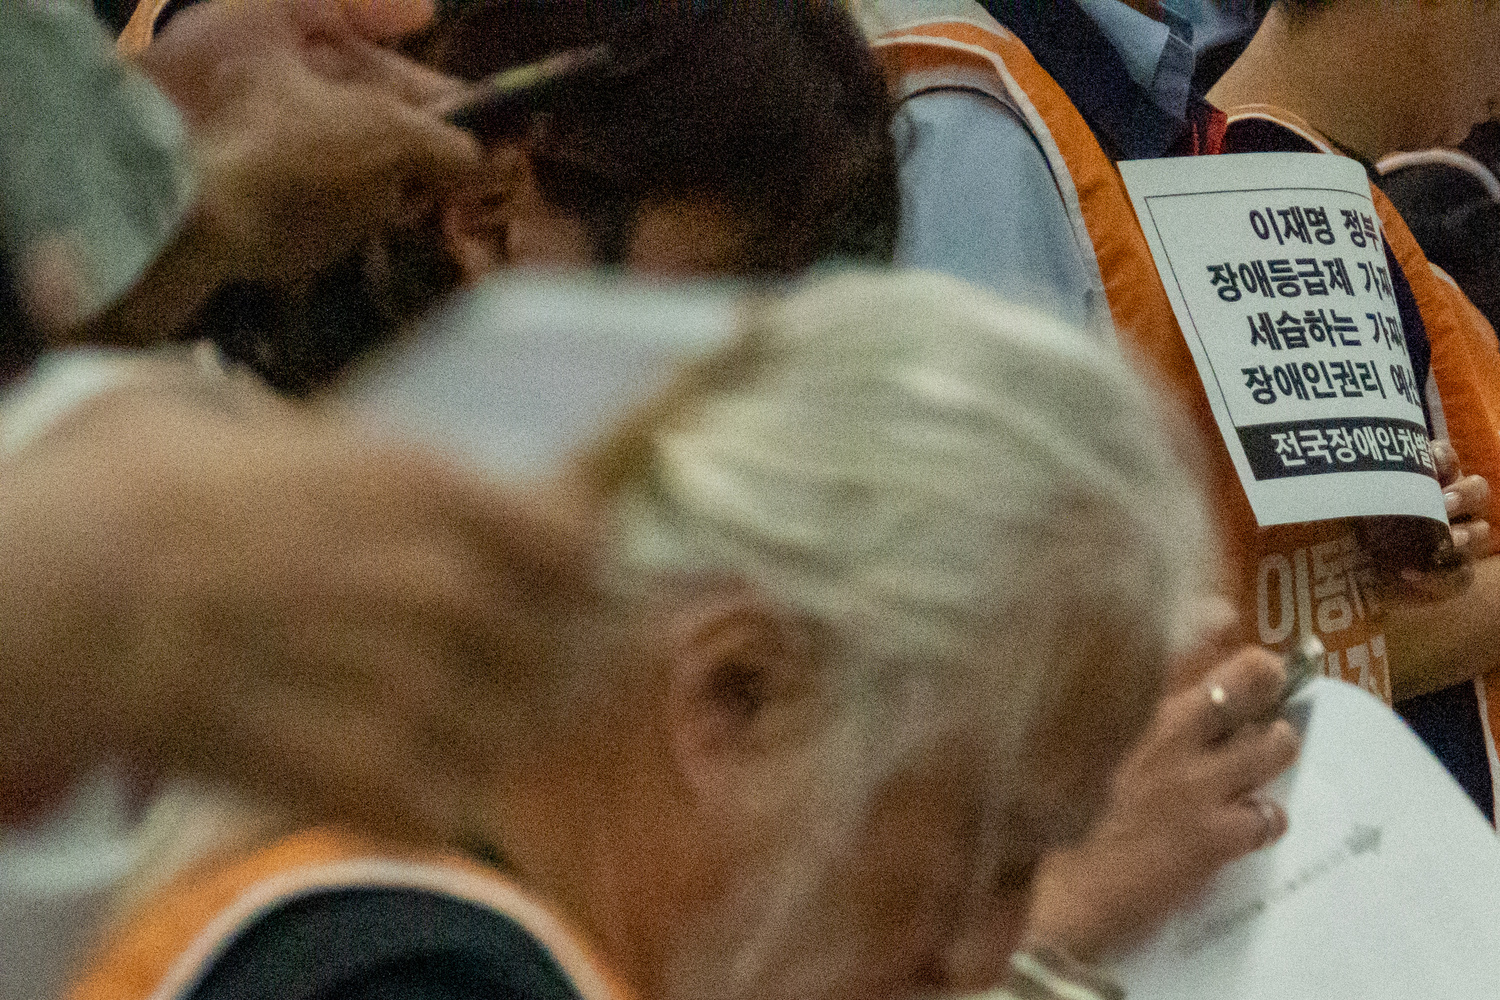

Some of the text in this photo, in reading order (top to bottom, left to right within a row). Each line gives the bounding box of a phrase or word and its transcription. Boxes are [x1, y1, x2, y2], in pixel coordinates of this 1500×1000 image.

[1249, 206, 1335, 246] 이재명
[1206, 257, 1355, 302] 장애등급제
[1247, 309, 1362, 351] 세습하는
[1241, 359, 1387, 405] 장애인권리
[1270, 428, 1438, 470] 전국장애인차별
